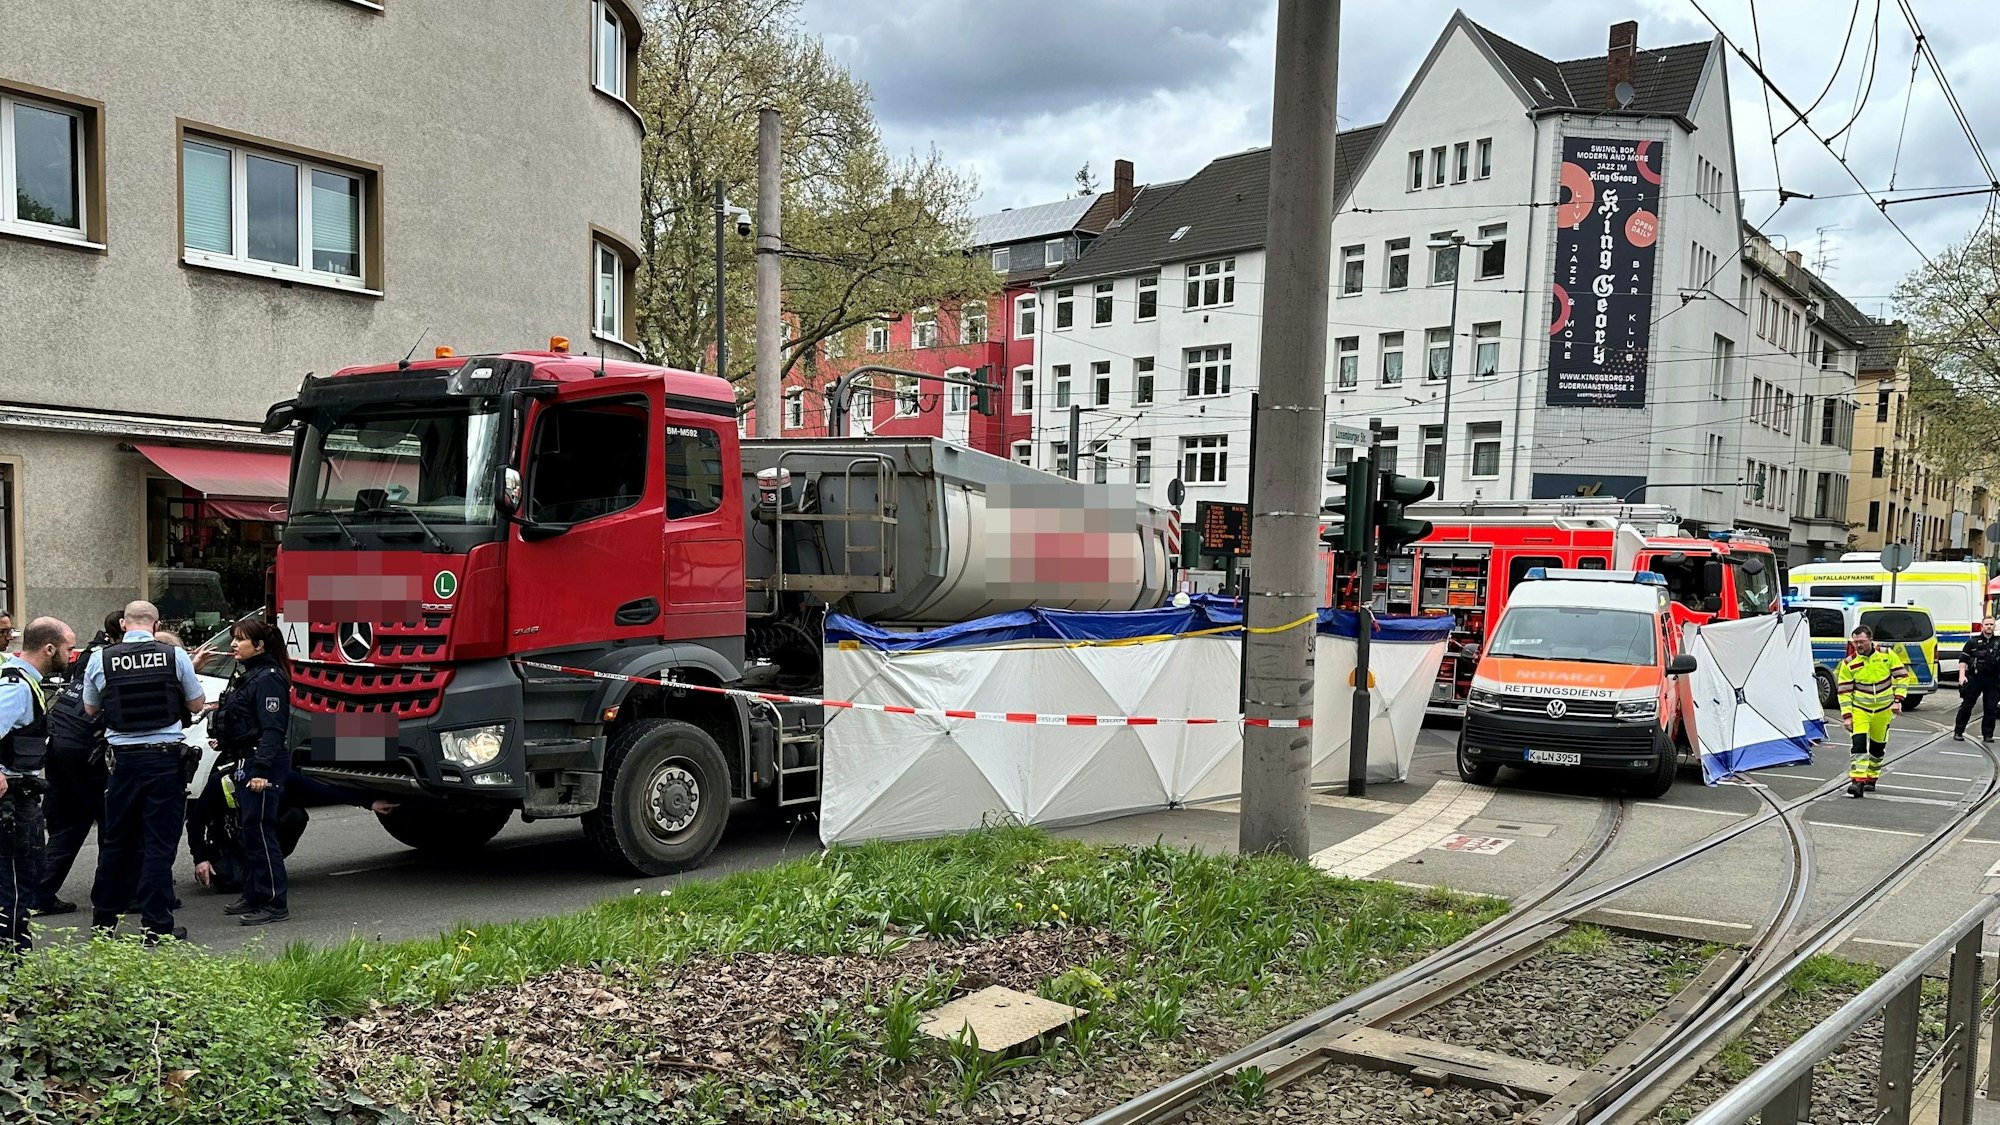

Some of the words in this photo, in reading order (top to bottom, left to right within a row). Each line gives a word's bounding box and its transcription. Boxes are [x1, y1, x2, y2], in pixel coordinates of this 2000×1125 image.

[1577, 152, 1608, 160] MODERN
[1591, 145, 1618, 154] SWING,
[1620, 147, 1636, 155] BOP,
[1589, 171, 1609, 184] King
[1611, 172, 1637, 185] Georg
[1572, 190, 1581, 230] LIVE
[1598, 189, 1620, 270] King
[1631, 225, 1652, 239] DAILY
[1634, 218, 1654, 232] OPEN
[1569, 244, 1578, 284] JAZZ
[1631, 260, 1640, 295] BAR
[1567, 298, 1576, 306] &
[1592, 274, 1616, 365] Georg
[1564, 319, 1575, 360] MORE
[1625, 313, 1637, 362] KLUB
[1559, 373, 1635, 382] WWW.KINGGEORG.DE
[1558, 382, 1627, 391] SUDERMANSTRASSE
[666, 426, 698, 438] BM-M592
[440, 576, 450, 593] L
[286, 621, 301, 653] A
[111, 652, 168, 671] POLIZEI
[1504, 684, 1616, 698] RETTUNGSDIENST
[1529, 751, 1536, 760] K
[1541, 752, 1555, 762] LN
[1555, 753, 1580, 763] 3951
